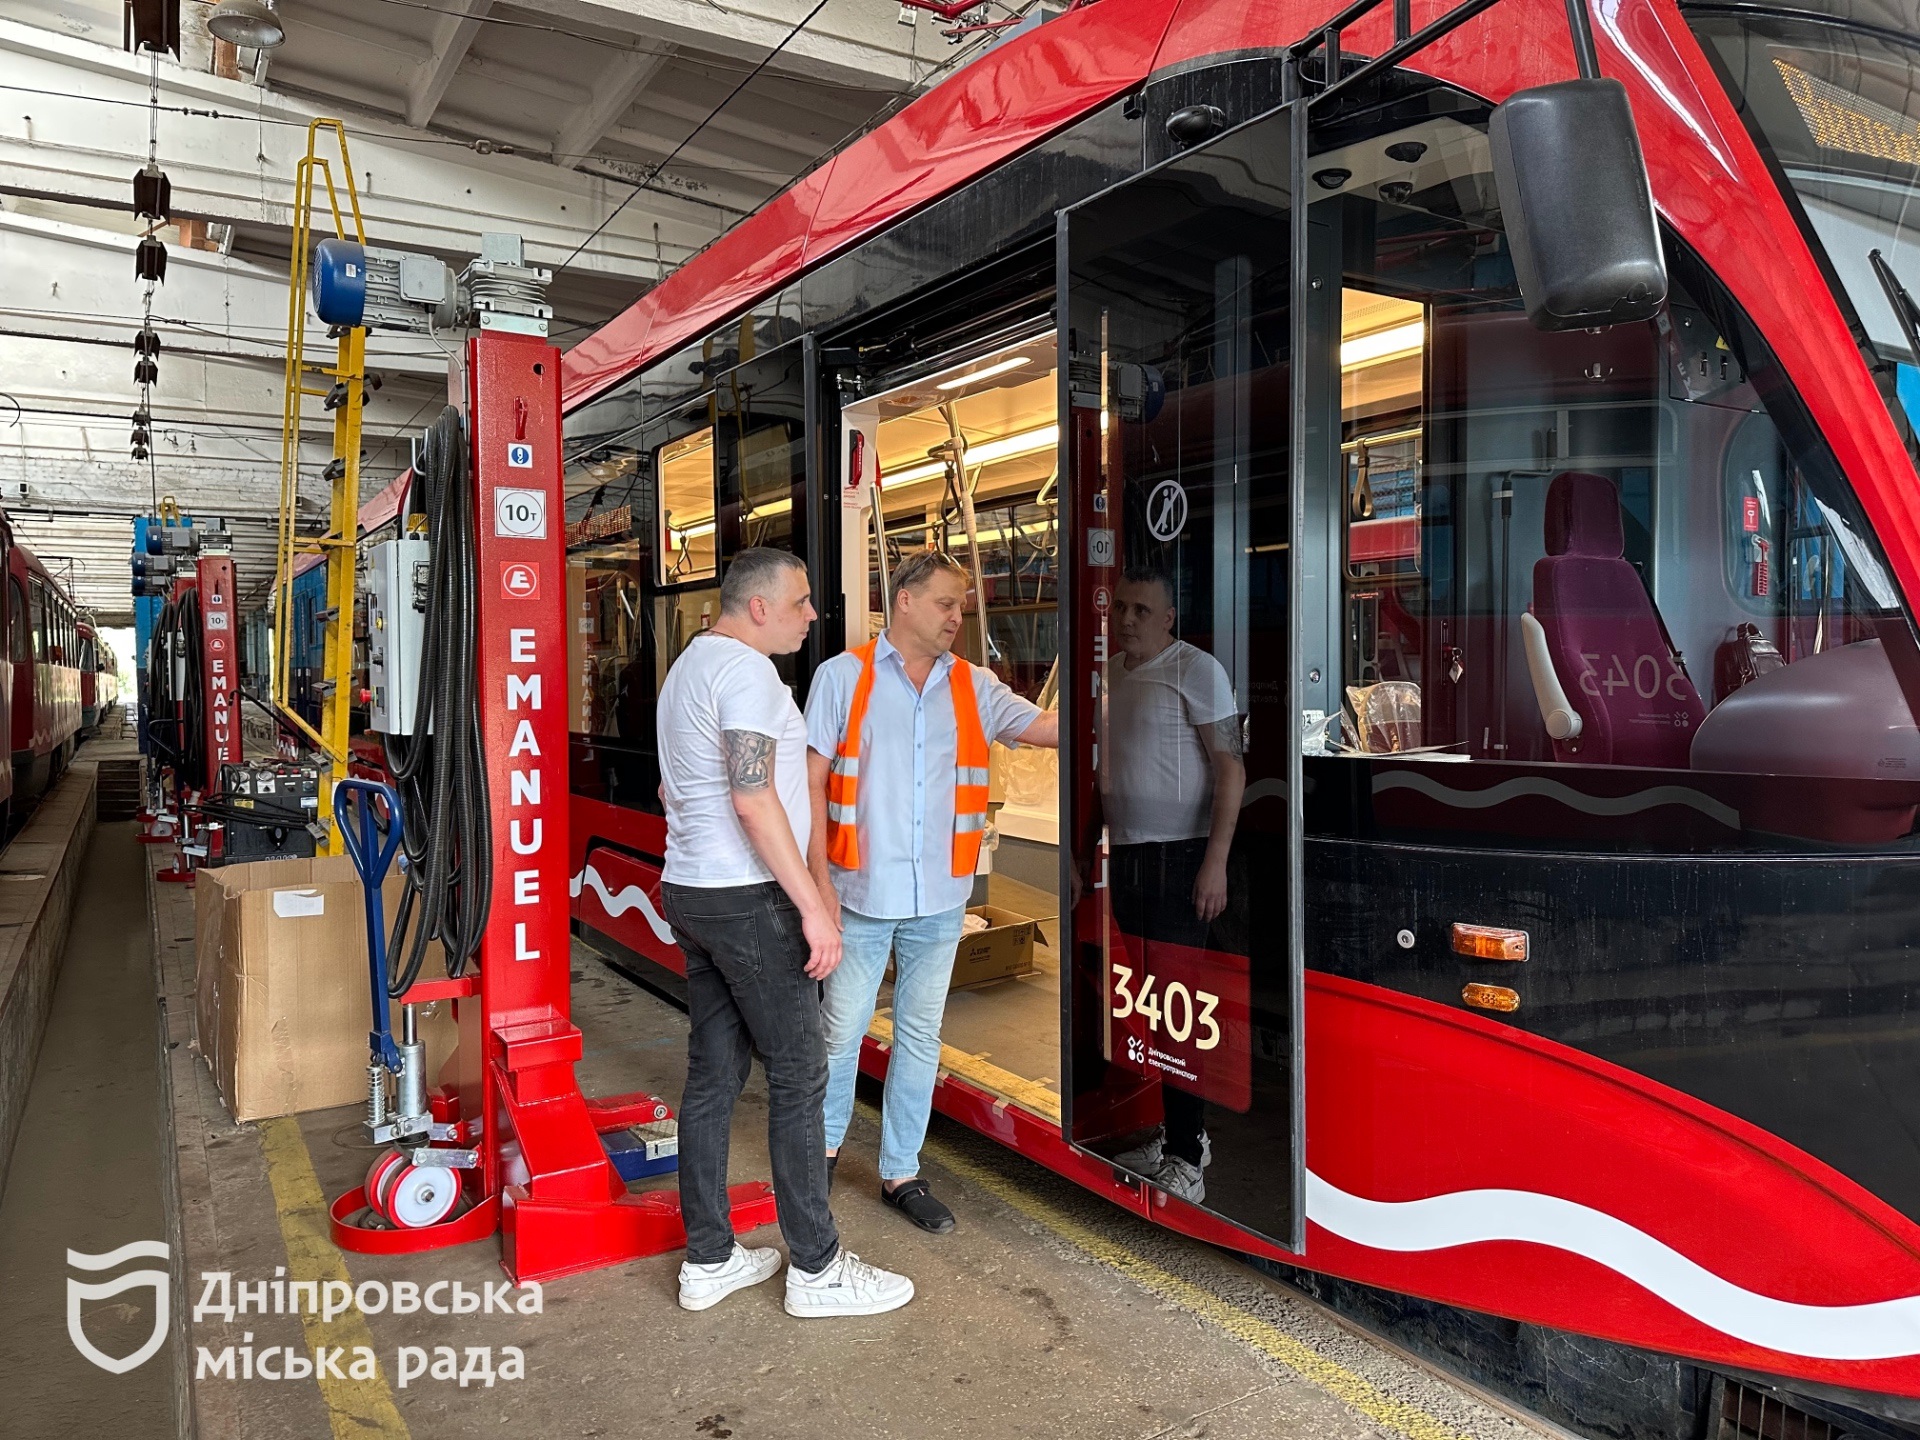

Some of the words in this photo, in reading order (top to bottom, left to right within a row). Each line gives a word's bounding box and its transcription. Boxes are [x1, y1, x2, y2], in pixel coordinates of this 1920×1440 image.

[211, 659, 230, 781] EMANUE
[507, 628, 542, 961] EMANUEL
[1112, 963, 1220, 1050] 3403
[1147, 1047, 1187, 1067] Дніпровський
[1147, 1058, 1198, 1082] електротранспорт
